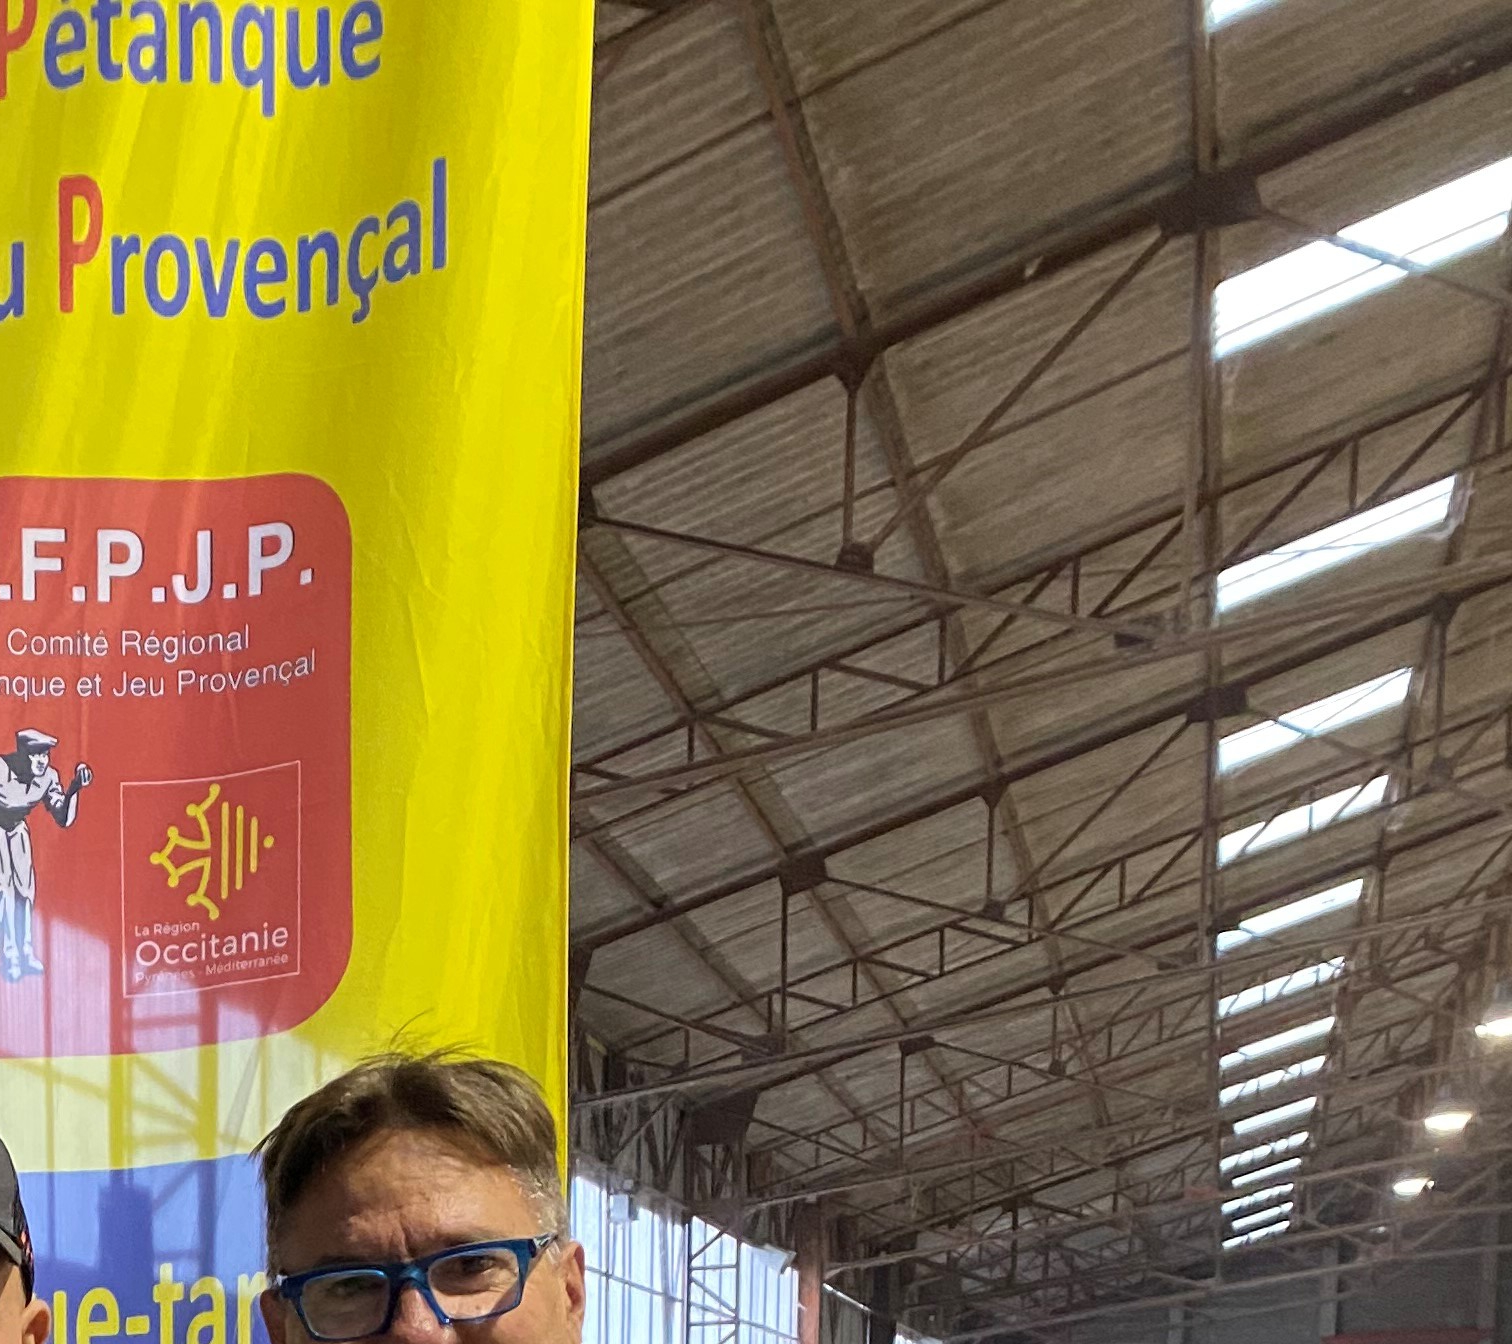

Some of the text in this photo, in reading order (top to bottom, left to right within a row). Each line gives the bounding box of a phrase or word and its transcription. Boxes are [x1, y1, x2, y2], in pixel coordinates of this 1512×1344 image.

[57, 156, 447, 324] Provençal
[6, 623, 250, 663] Comité Régional
[76, 674, 103, 697] et
[113, 670, 165, 698] Jeu
[177, 648, 316, 695] Provençal
[134, 921, 200, 937] La Région
[135, 922, 289, 966] Occitanie
[205, 952, 289, 976] Méditerranée
